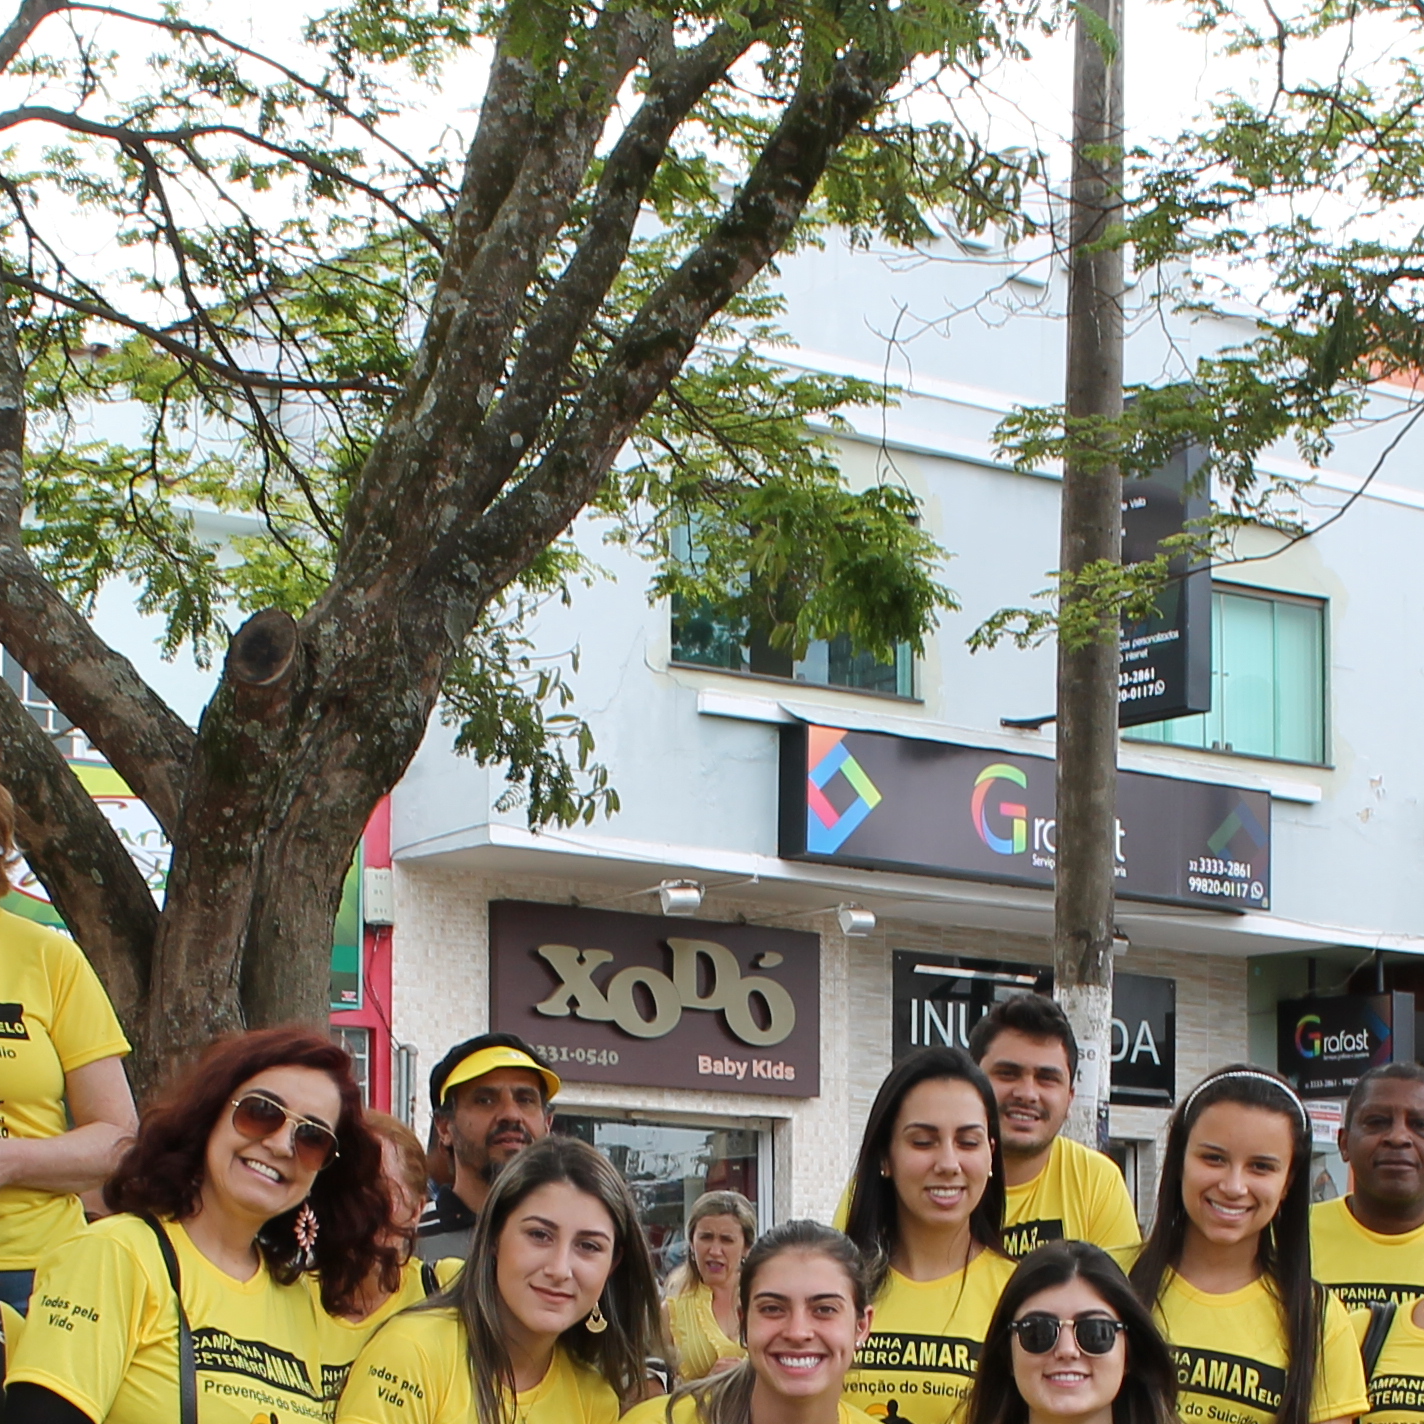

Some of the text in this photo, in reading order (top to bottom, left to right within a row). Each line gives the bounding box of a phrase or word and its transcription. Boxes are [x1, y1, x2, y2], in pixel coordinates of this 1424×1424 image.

[1198, 856, 1251, 879] 3333-2861
[1188, 876, 1248, 898] 99820-0117
[1294, 1014, 1369, 1059] Grafast
[698, 1054, 796, 1081] Baby Kids
[48, 1314, 74, 1332] Vida
[71, 1303, 99, 1323] pela
[401, 1379, 425, 1400] pela
[899, 1380, 918, 1394] do
[1190, 1357, 1282, 1408] AMARELO
[377, 1386, 405, 1408] Vida
[1185, 1402, 1203, 1416] do
